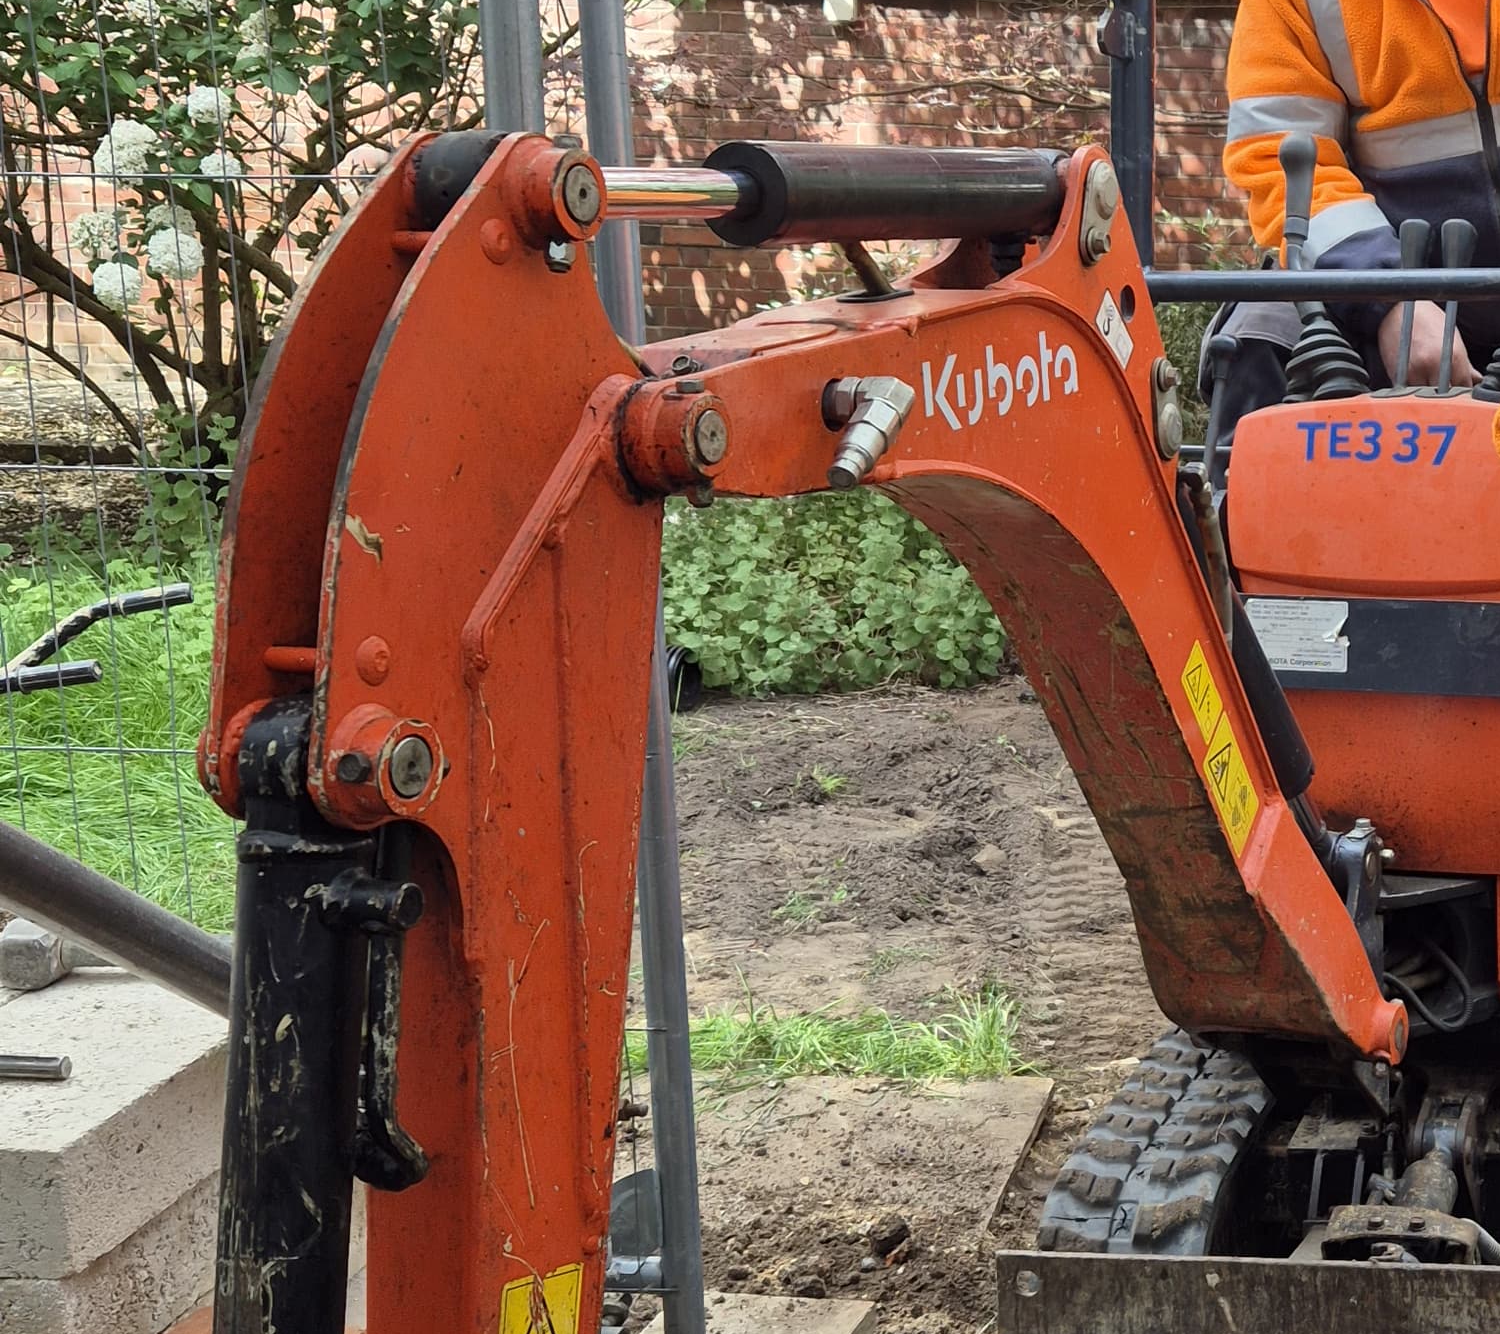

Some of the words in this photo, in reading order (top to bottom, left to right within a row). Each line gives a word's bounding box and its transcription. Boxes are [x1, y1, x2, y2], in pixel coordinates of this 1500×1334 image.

[921, 330, 1079, 431] Kubota
[1297, 420, 1457, 466] TE337
[1290, 658, 1332, 667] Corporation
